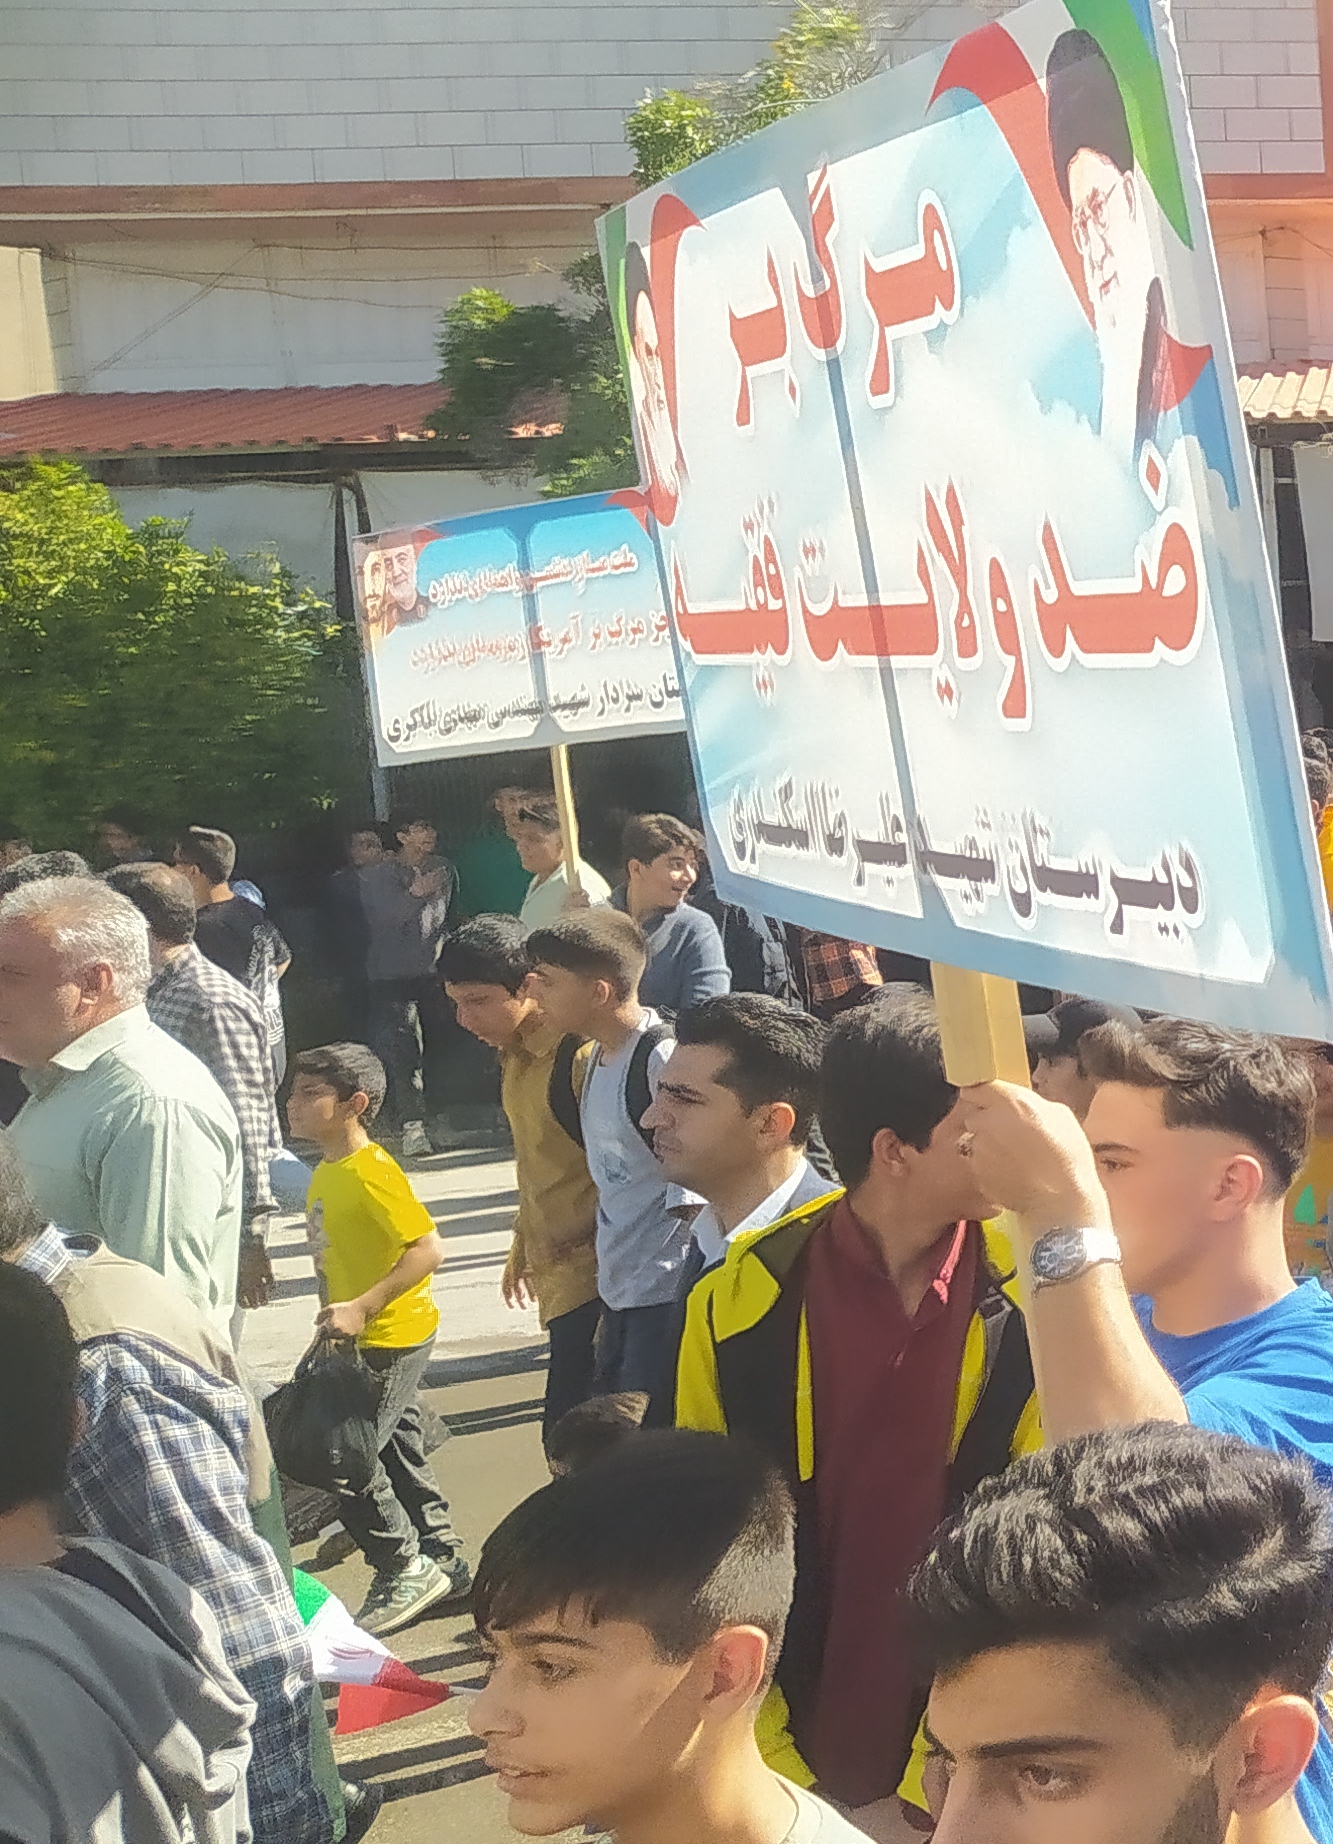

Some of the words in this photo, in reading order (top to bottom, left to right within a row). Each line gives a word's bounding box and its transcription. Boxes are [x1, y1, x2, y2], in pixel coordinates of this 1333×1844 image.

[727, 245, 802, 428] بر
[793, 166, 957, 398] مرگ
[676, 503, 787, 693] فقیه
[801, 480, 1032, 718] ولایت
[1036, 457, 1194, 656] ضد
[1006, 805, 1200, 936] دبیرستان
